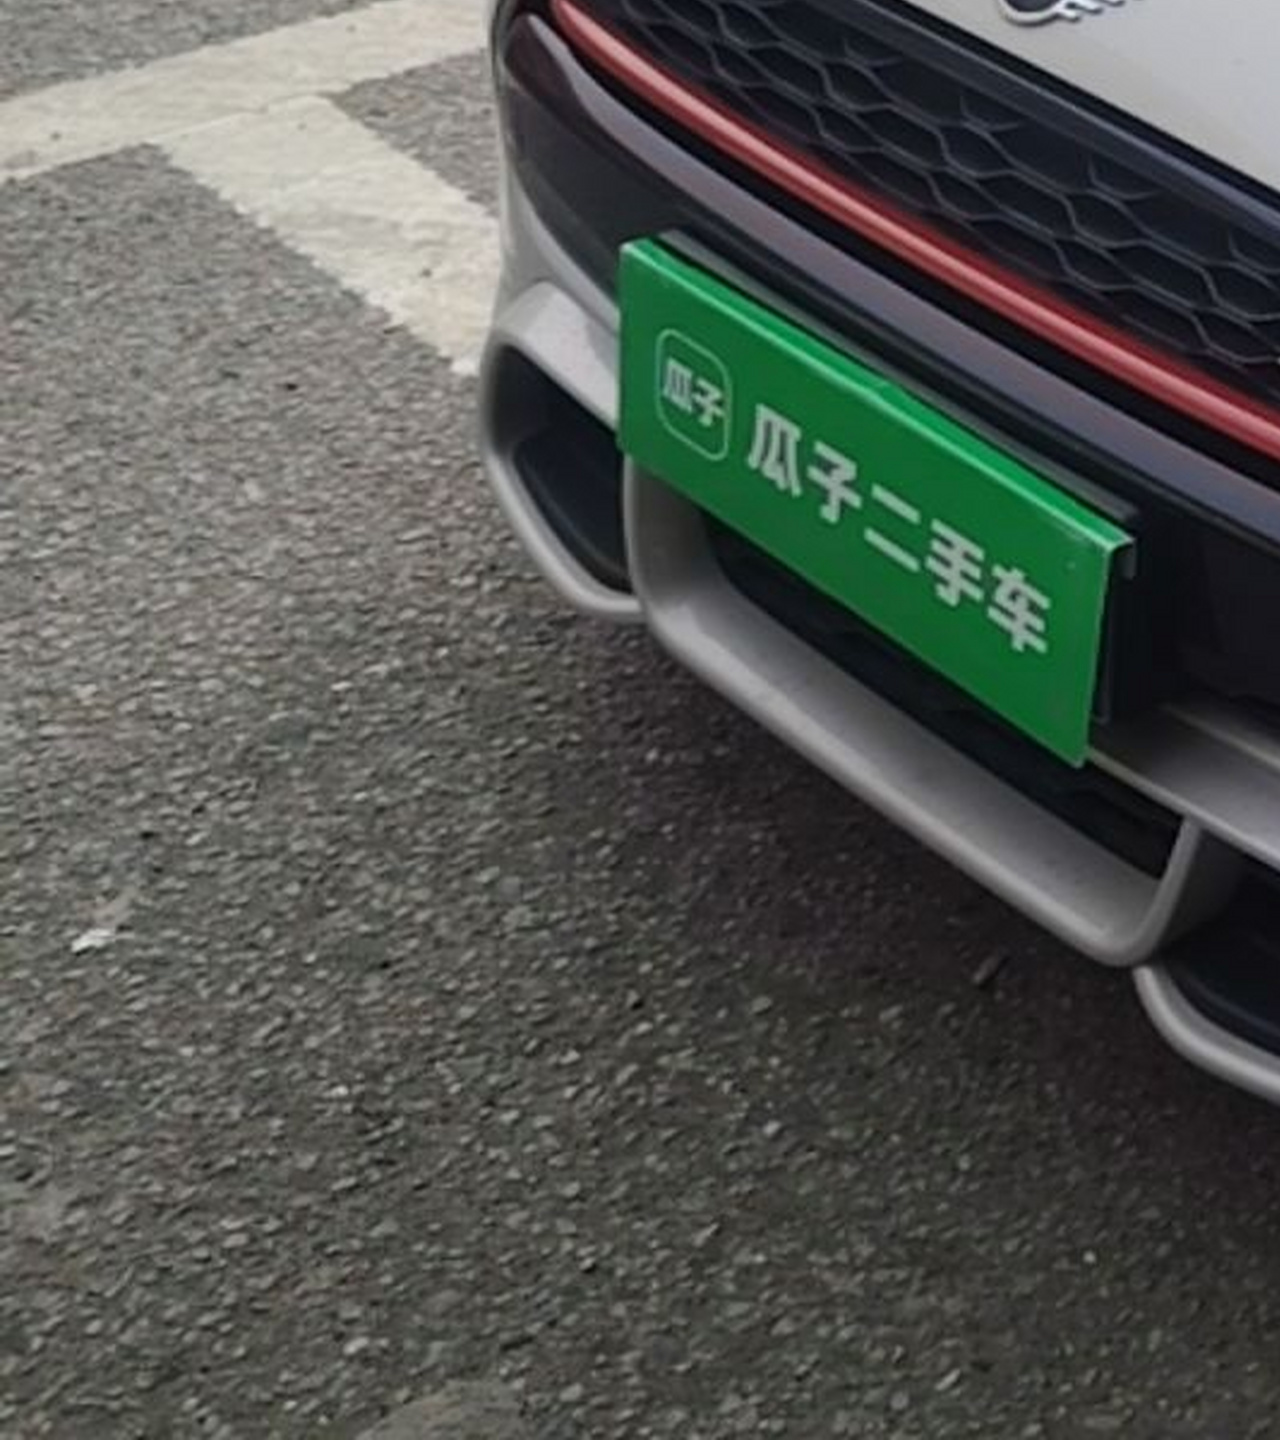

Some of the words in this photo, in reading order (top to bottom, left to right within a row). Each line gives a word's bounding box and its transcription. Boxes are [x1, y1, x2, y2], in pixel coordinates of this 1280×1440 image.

[660, 358, 724, 428] 瓜子
[747, 403, 1051, 654] 瓜子二手车
